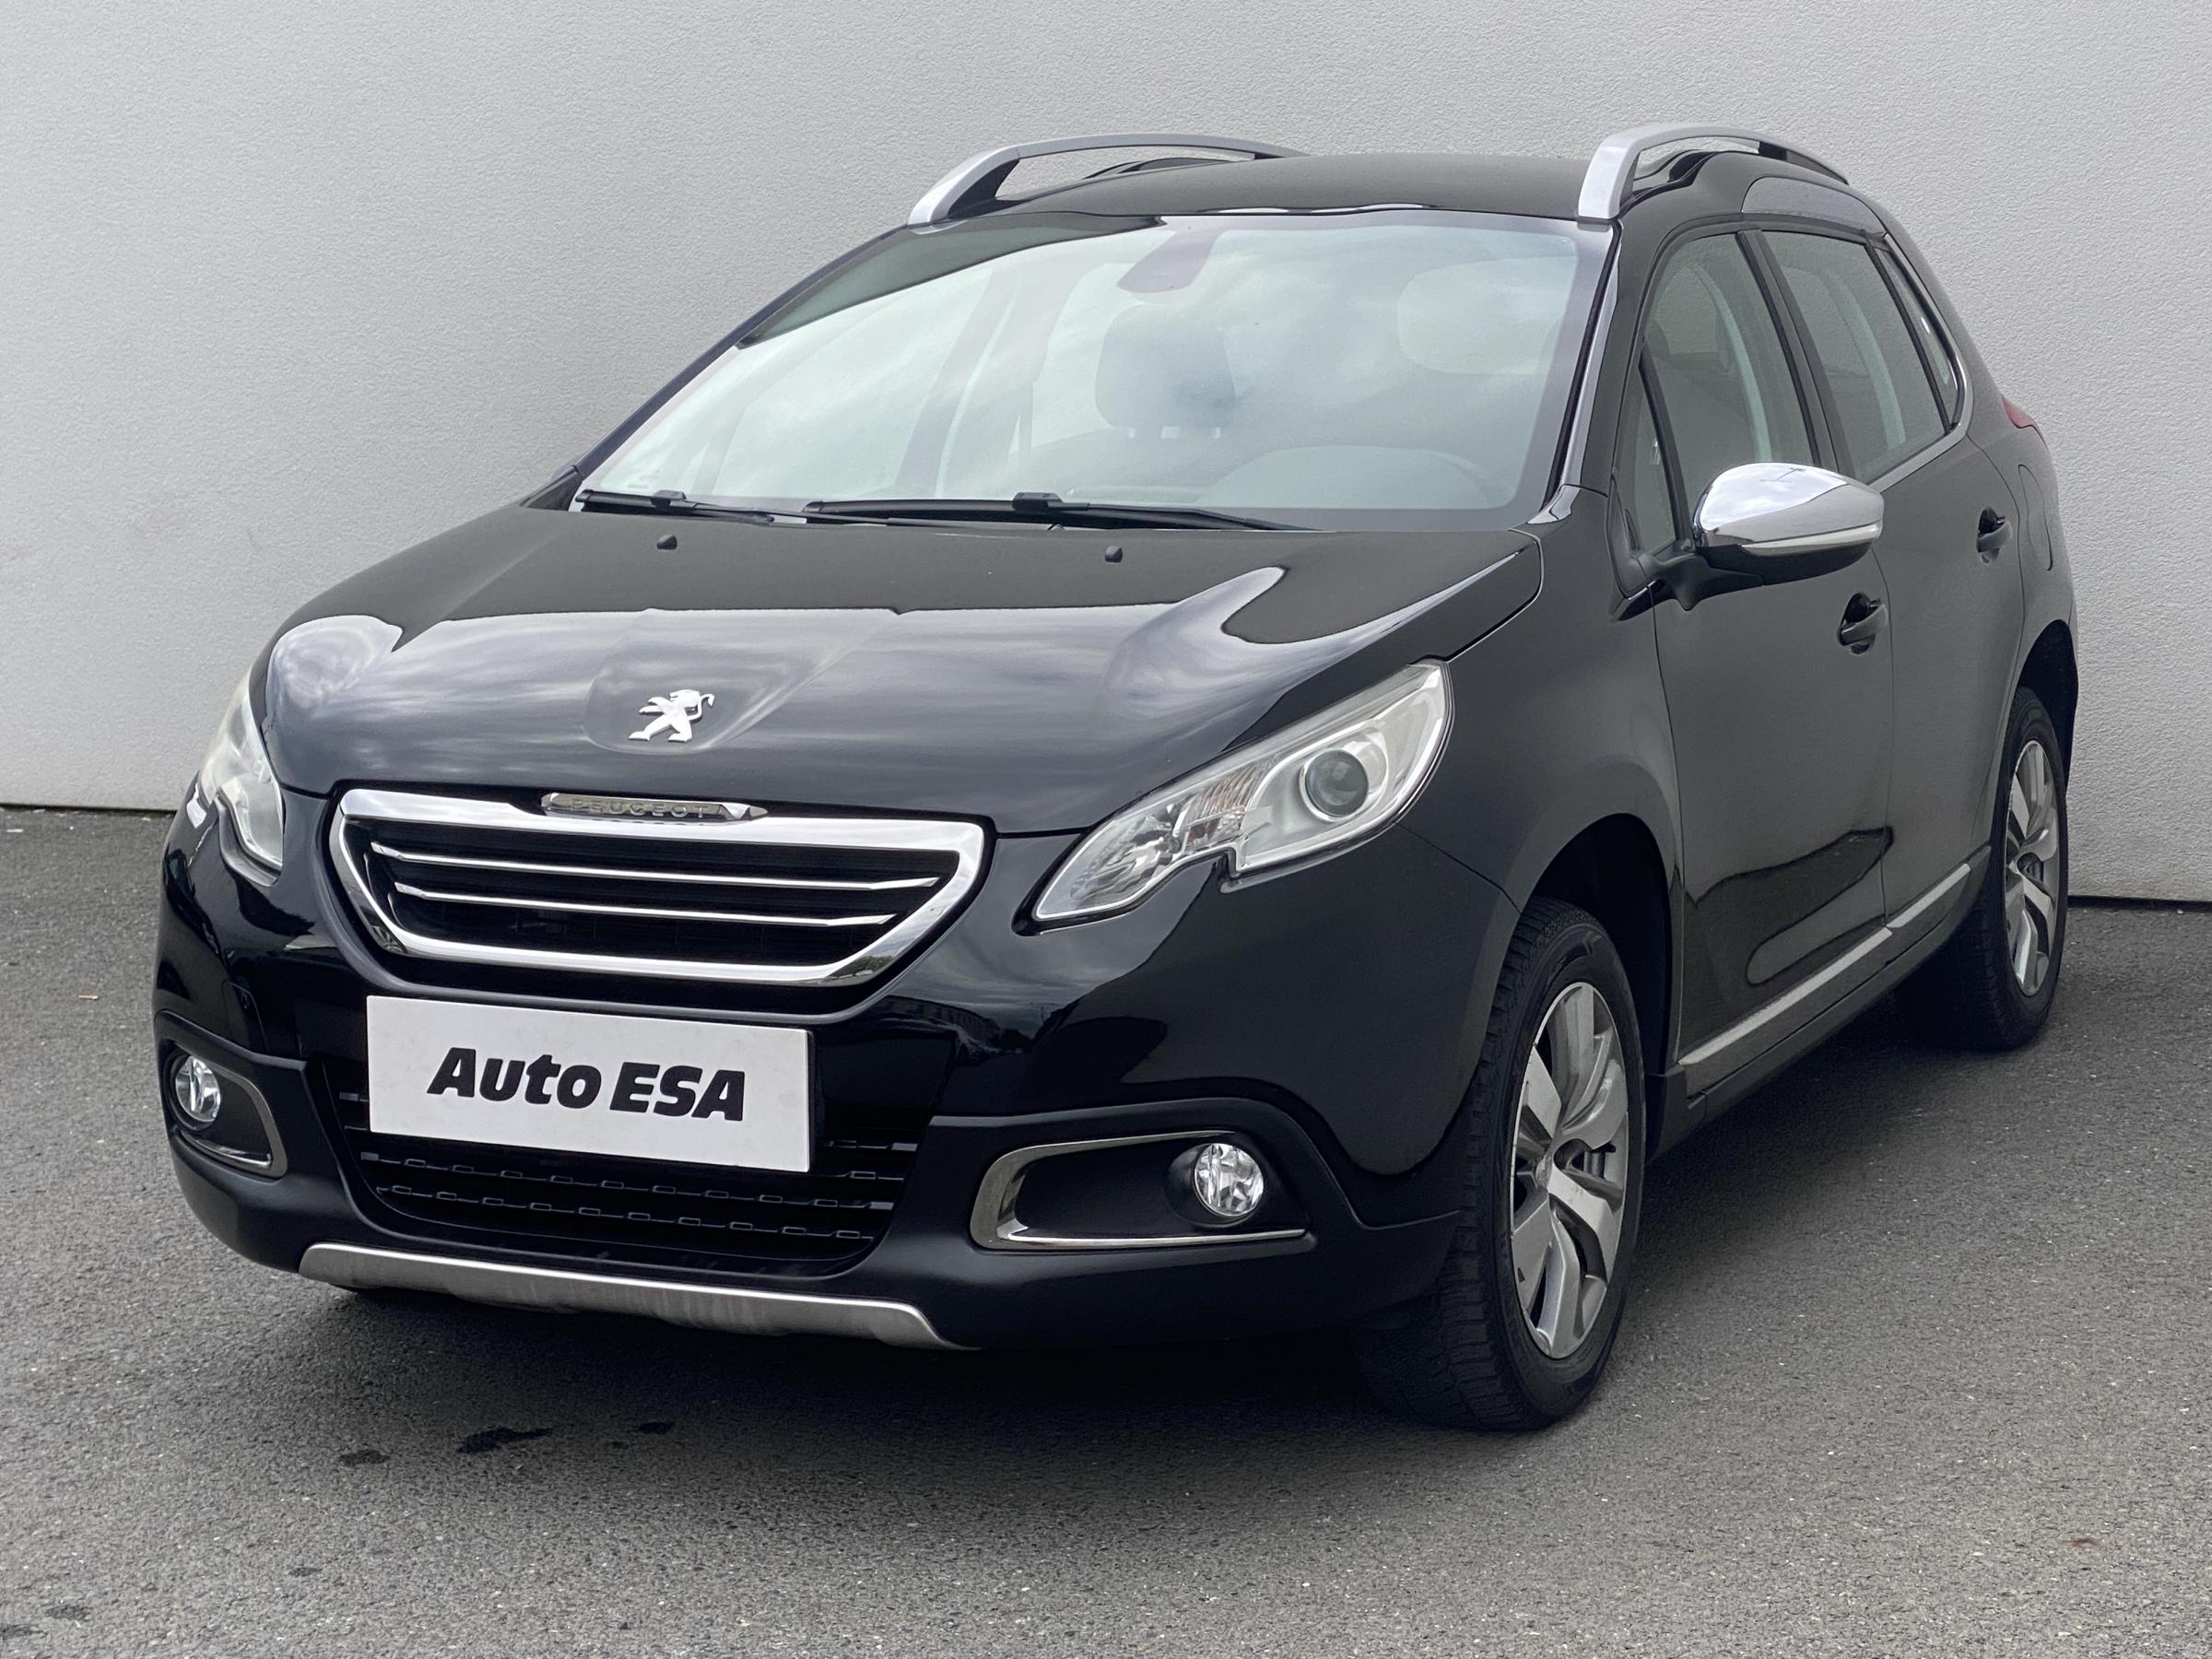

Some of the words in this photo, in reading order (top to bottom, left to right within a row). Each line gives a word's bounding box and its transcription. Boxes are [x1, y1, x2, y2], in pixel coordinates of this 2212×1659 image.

[571, 798, 709, 818] PEUGEOT
[427, 1047, 602, 1109] Auto
[609, 1061, 746, 1122] ESA
